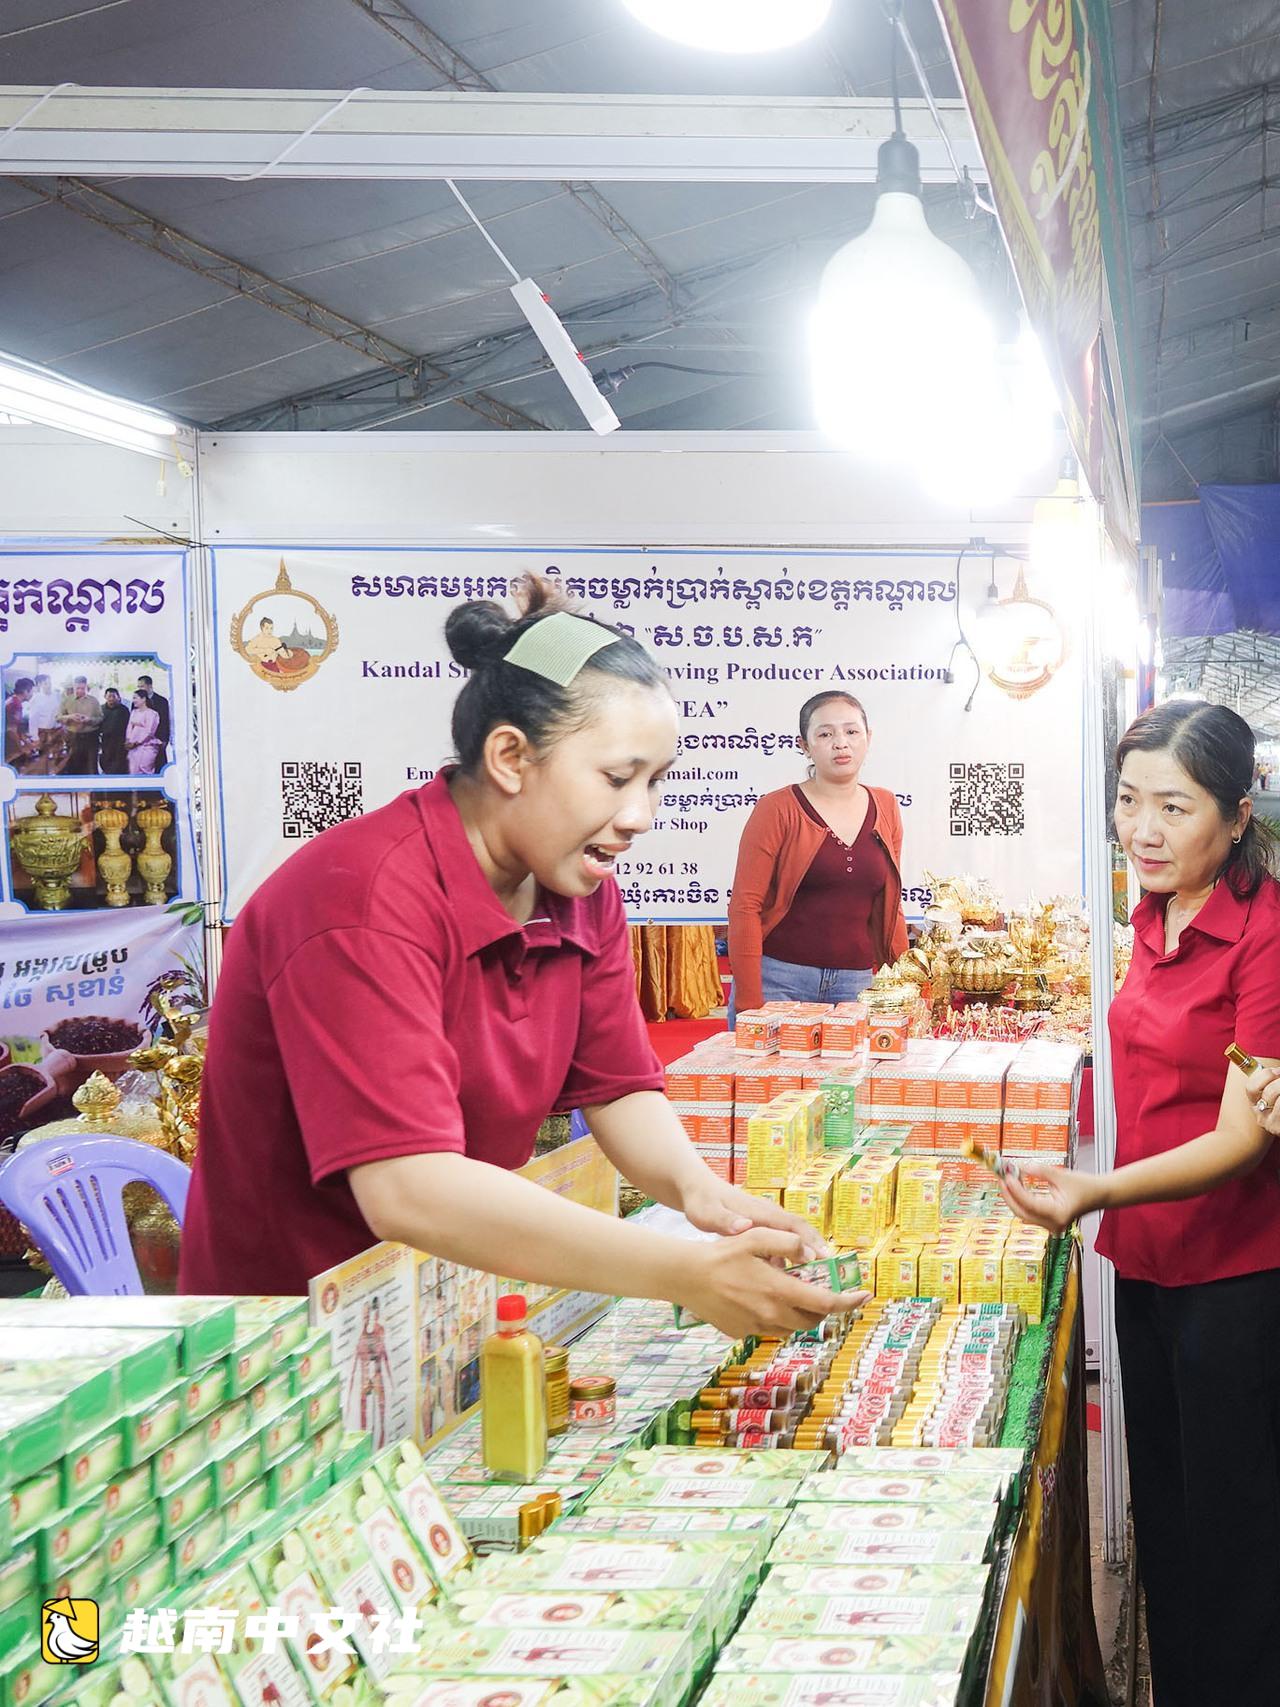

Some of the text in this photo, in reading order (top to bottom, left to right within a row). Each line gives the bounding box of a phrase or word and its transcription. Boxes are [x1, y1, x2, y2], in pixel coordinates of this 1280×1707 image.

[361, 660, 441, 679] Kandal
[726, 662, 825, 682] Producer
[830, 662, 950, 682] Association
[666, 767, 739, 781] mail.com
[670, 818, 708, 833] Shop
[636, 862, 653, 875] 92
[658, 862, 675, 875] 61
[680, 862, 698, 875] 38
